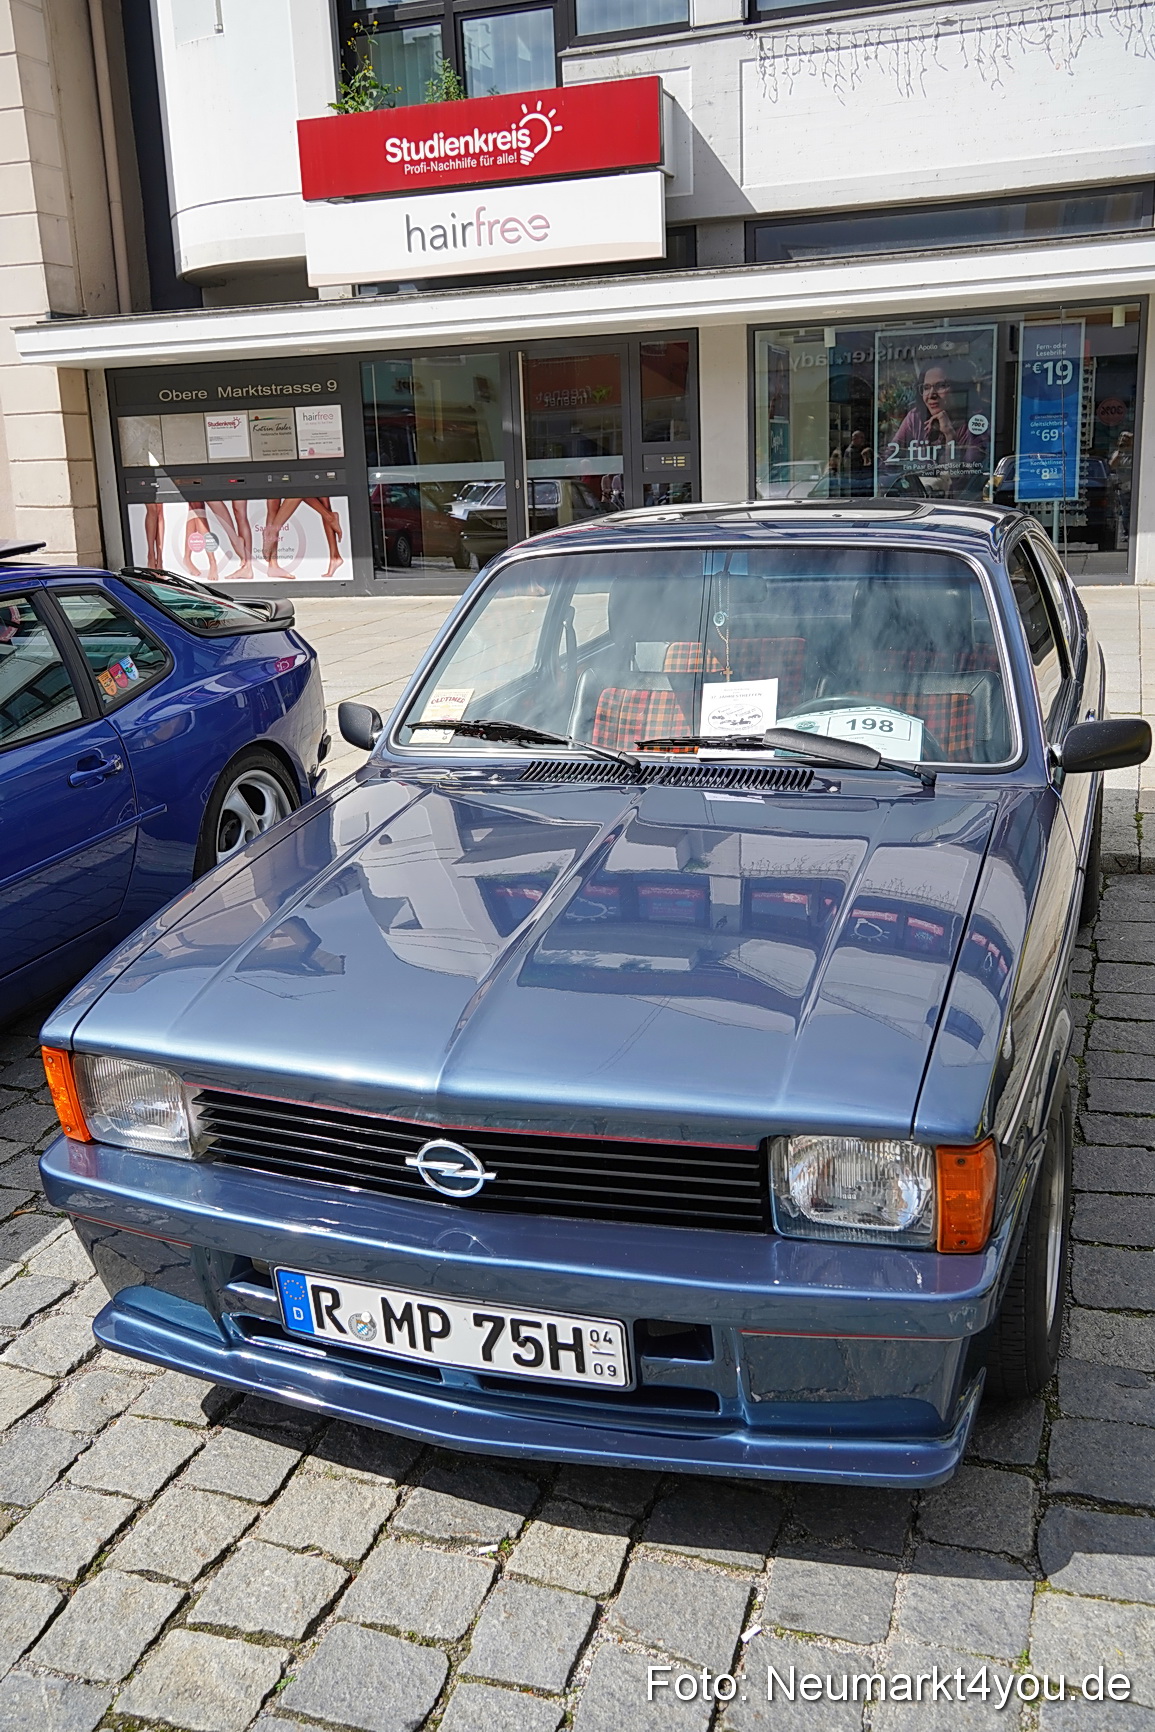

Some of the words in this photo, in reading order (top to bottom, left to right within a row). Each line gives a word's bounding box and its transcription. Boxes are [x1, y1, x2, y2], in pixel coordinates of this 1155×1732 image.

[386, 123, 531, 163] Studienkreis
[404, 156, 477, 175] Profi-Nachhilfe
[480, 155, 494, 167] für
[497, 152, 517, 164] alle!
[406, 206, 550, 253] hairfree
[159, 389, 208, 401] Obere
[217, 382, 322, 398] Marktstrasse
[327, 380, 338, 392] 9
[303, 411, 334, 421] hairfree
[886, 443, 900, 462] 2
[908, 440, 941, 461] für
[947, 440, 955, 459] 1
[846, 718, 894, 732] 198
[292, 1307, 304, 1321] D
[311, 1284, 347, 1334] R
[380, 1296, 450, 1352] MP
[473, 1312, 586, 1374] 75H
[590, 1329, 613, 1345] 04
[593, 1362, 617, 1377] 09
